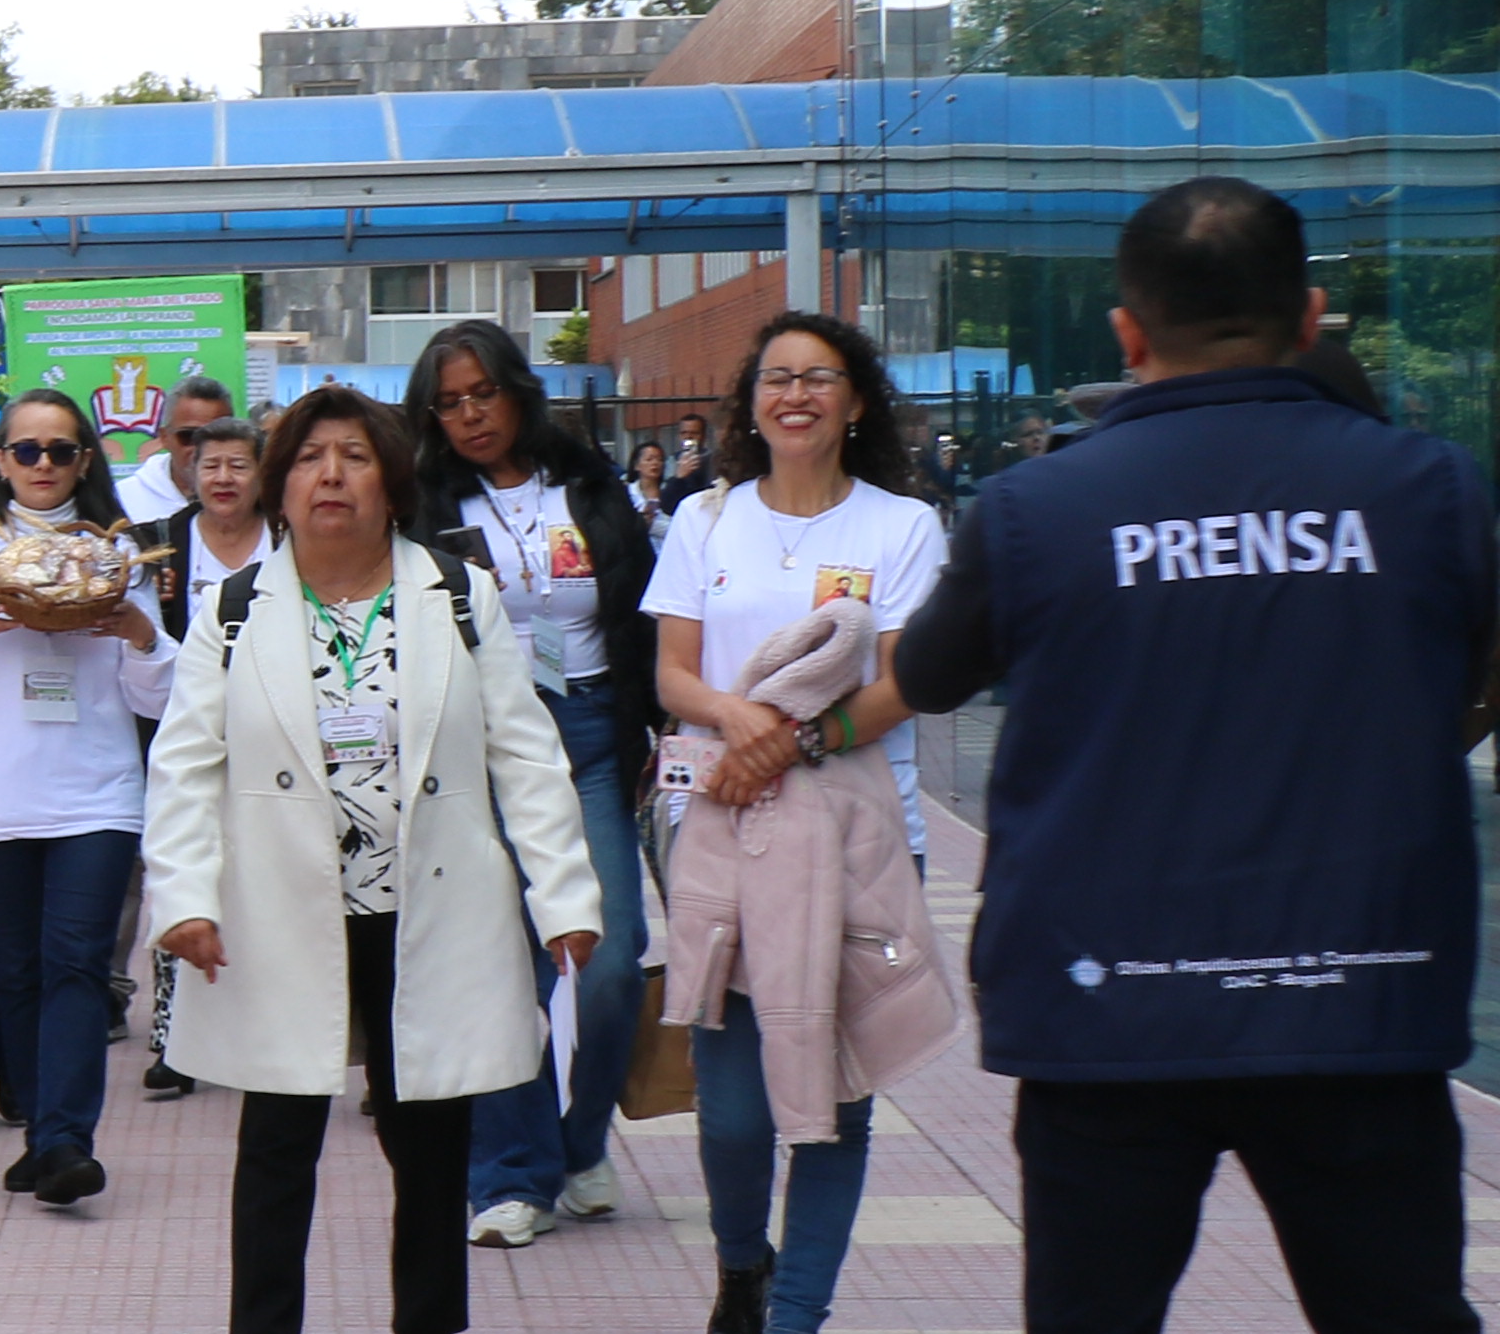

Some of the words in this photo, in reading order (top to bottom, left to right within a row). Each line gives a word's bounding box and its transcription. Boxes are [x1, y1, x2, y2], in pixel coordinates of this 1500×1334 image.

[184, 293, 223, 304] PRADO
[134, 311, 196, 323] ESPERANZA
[1111, 509, 1378, 587] PRENSA
[1294, 953, 1320, 968] de
